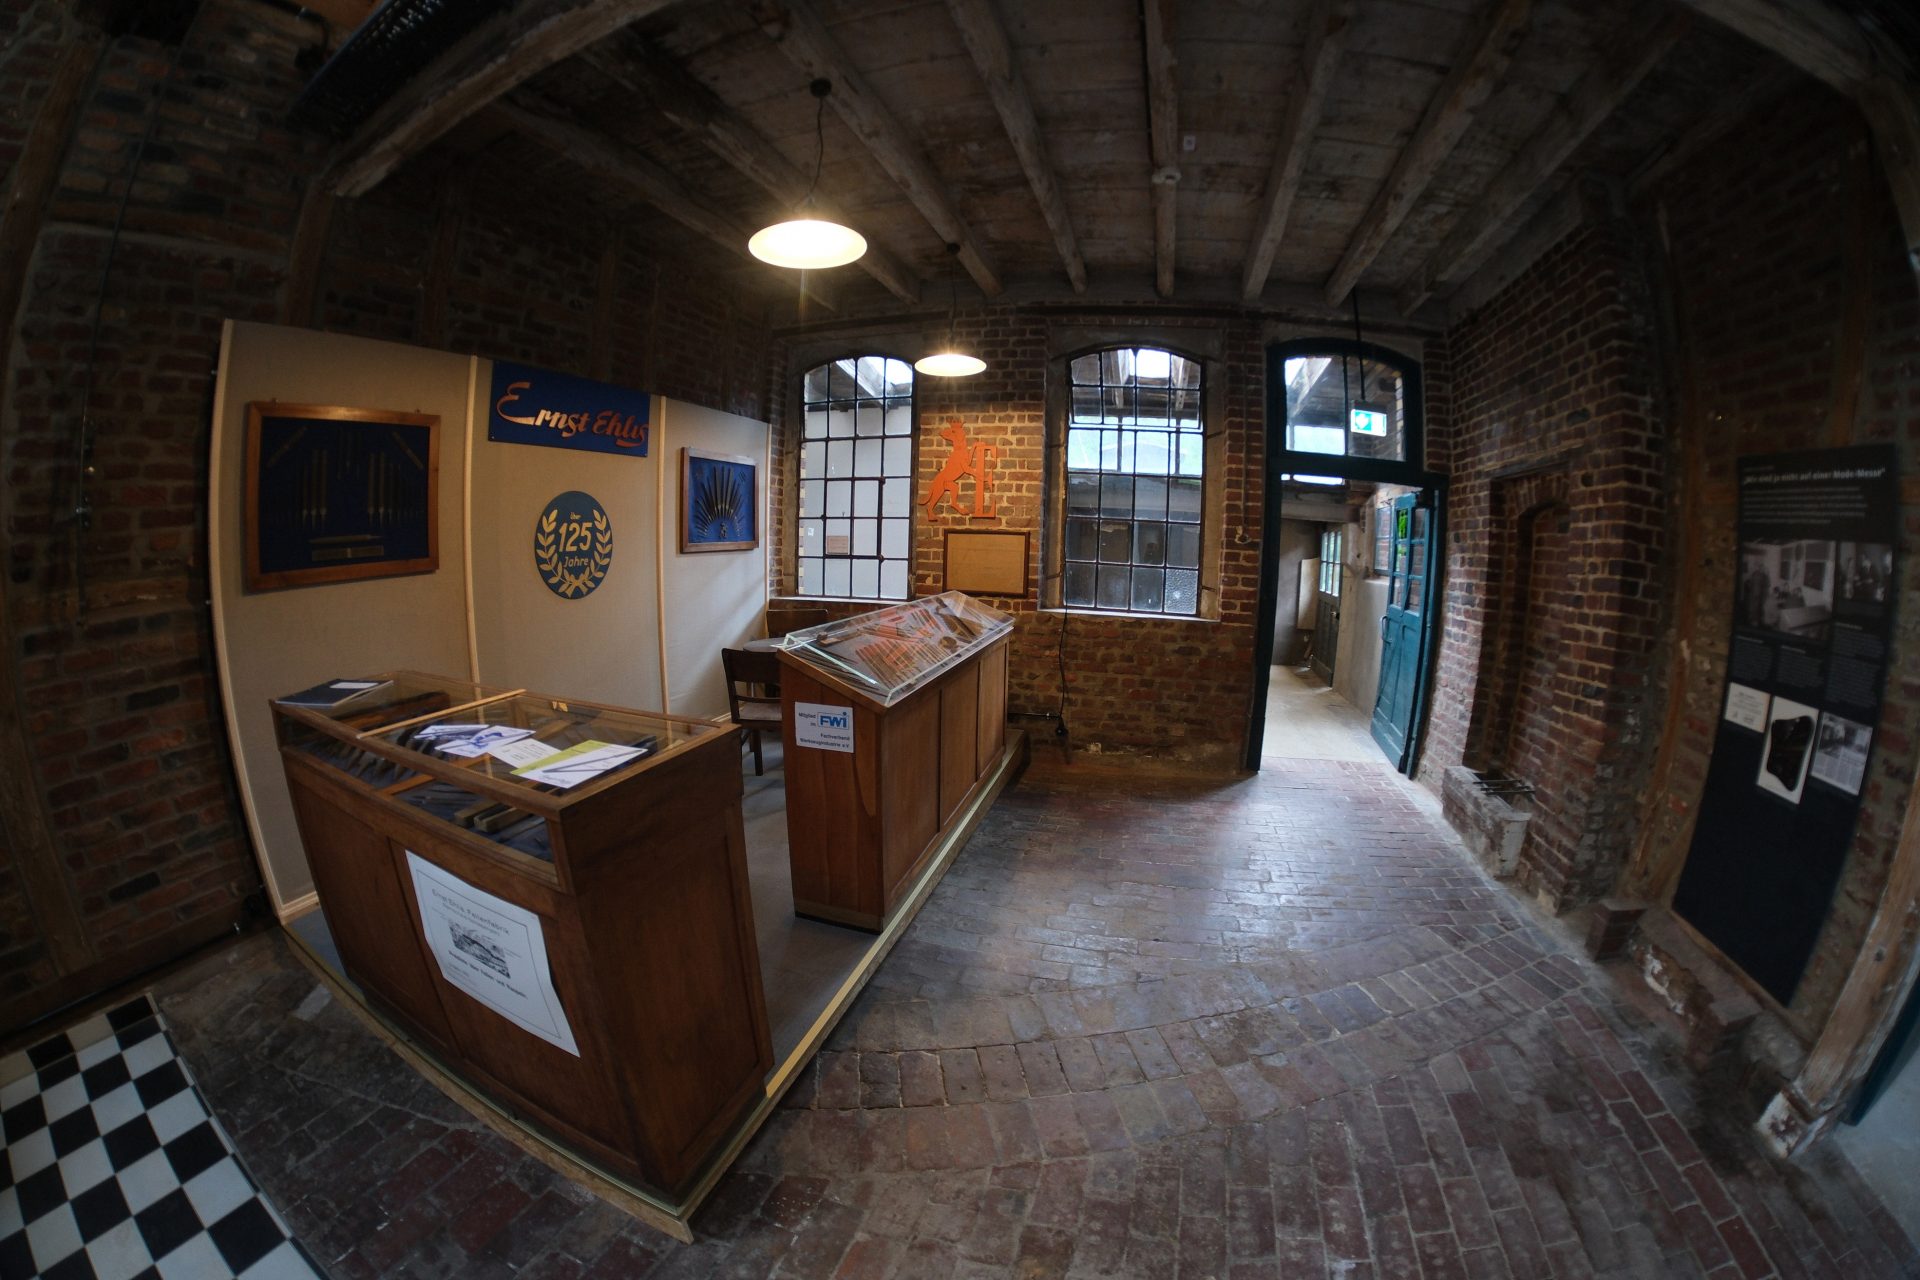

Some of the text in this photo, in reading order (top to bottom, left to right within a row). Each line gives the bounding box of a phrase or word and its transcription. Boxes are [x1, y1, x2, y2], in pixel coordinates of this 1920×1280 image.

[497, 381, 649, 448] Ernst Ehlis
[559, 522, 593, 552] 125
[564, 555, 590, 568] Jahre
